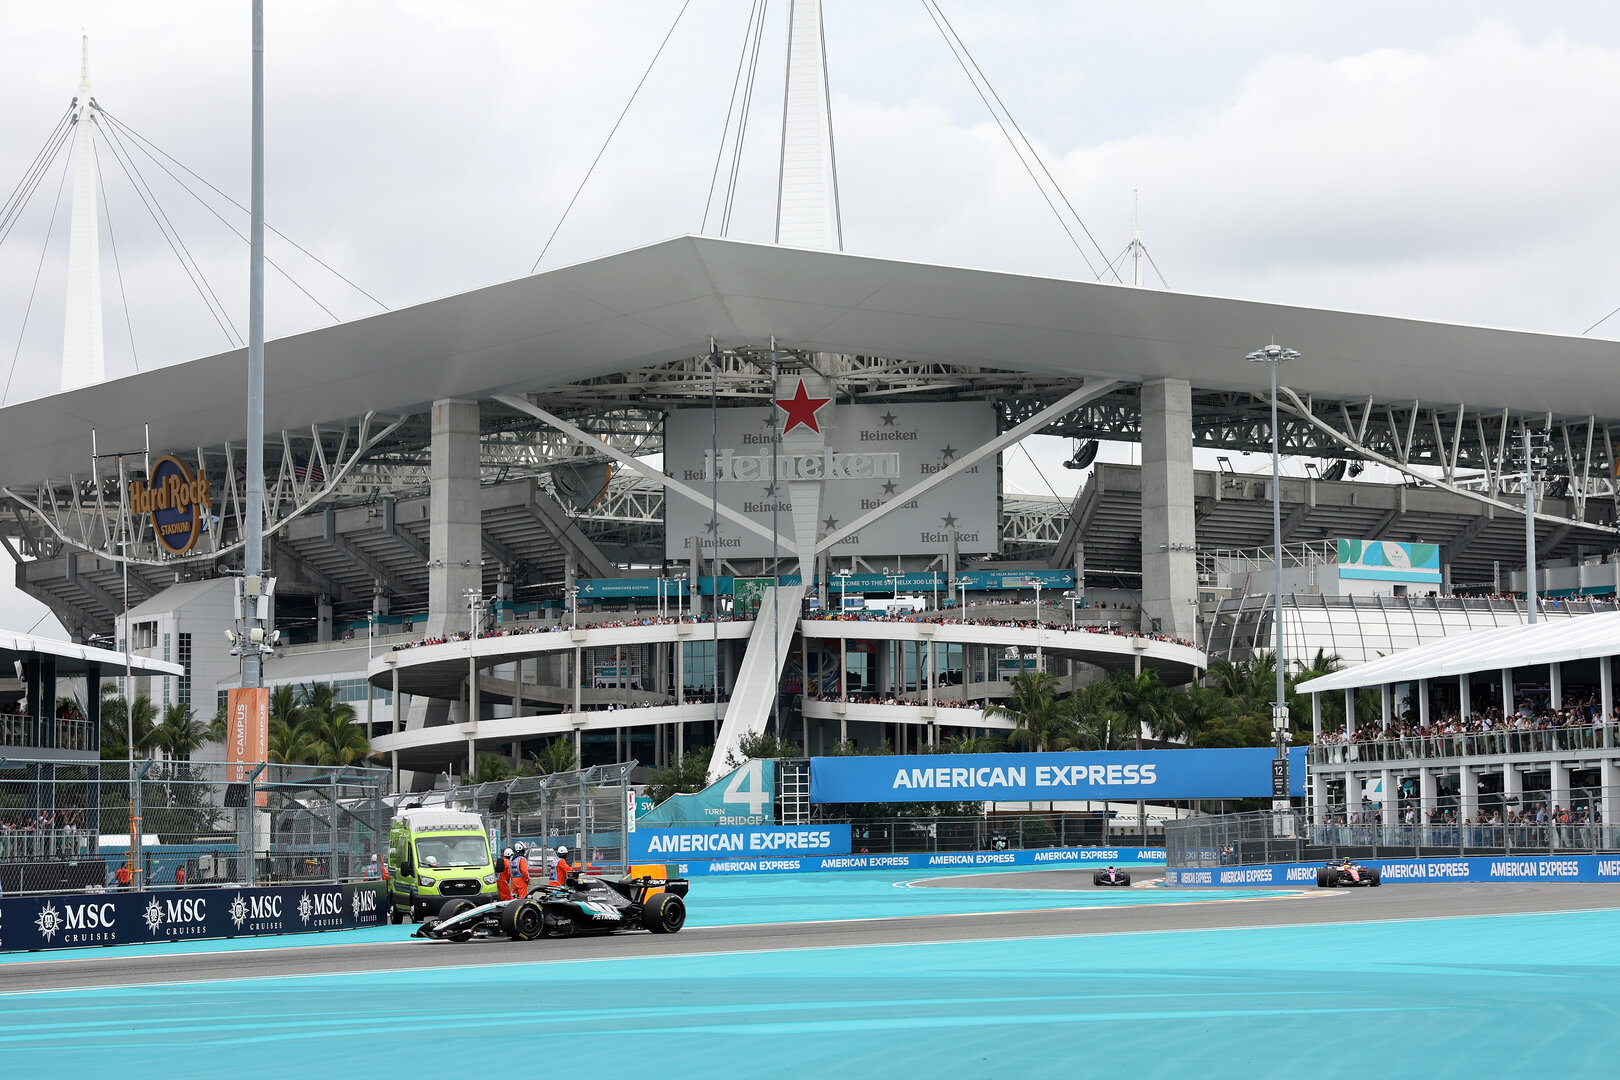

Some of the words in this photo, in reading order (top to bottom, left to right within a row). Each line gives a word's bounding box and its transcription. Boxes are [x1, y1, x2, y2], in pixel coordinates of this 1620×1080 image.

[860, 430, 918, 441] Heineken
[704, 447, 900, 482] Heineken
[129, 476, 171, 515] Hard
[168, 469, 213, 514] Rock
[743, 501, 792, 512] Heineke
[161, 522, 191, 536] STADIUM
[684, 537, 741, 549] Hineken
[920, 531, 979, 543] Heinken
[236, 703, 245, 755] CAMPUS
[892, 766, 1026, 789] AMERICAN
[1035, 764, 1157, 786] EXPRESS
[1274, 766, 1284, 776] 12
[723, 759, 770, 815] 4
[641, 802, 656, 811] SW
[704, 808, 725, 816] TURN
[719, 816, 763, 826] BRIDGE
[647, 833, 744, 853] AMERICAN
[750, 831, 831, 850] EXPRESS
[820, 857, 867, 868] AMERICAN
[869, 856, 910, 867] EXPRESS
[928, 854, 974, 865] AMERICAN
[976, 853, 1016, 864] EXPRESS
[1034, 851, 1079, 861] AMERICAN
[1080, 850, 1119, 860] EXPRESS
[709, 861, 757, 872] AMERICAN
[759, 860, 801, 871] EXPRESS
[1381, 864, 1426, 878] AMERICAN
[1428, 862, 1470, 877] EXPRESS
[1490, 862, 1538, 877] AMERICAN
[1539, 860, 1579, 876] EXPRESS
[1220, 870, 1246, 883] AMERICAN
[1246, 868, 1273, 882] EXPRESS
[1286, 866, 1321, 881] AMERICA
[249, 895, 282, 919] MSC
[313, 892, 343, 916] MSC
[360, 889, 377, 912] MSC
[64, 902, 116, 930] MSC
[166, 897, 206, 924] MSC
[249, 921, 283, 931] CRUISES
[313, 918, 343, 927] CRUISES
[64, 931, 116, 942] CRUISES
[166, 925, 207, 936] CRUISES
